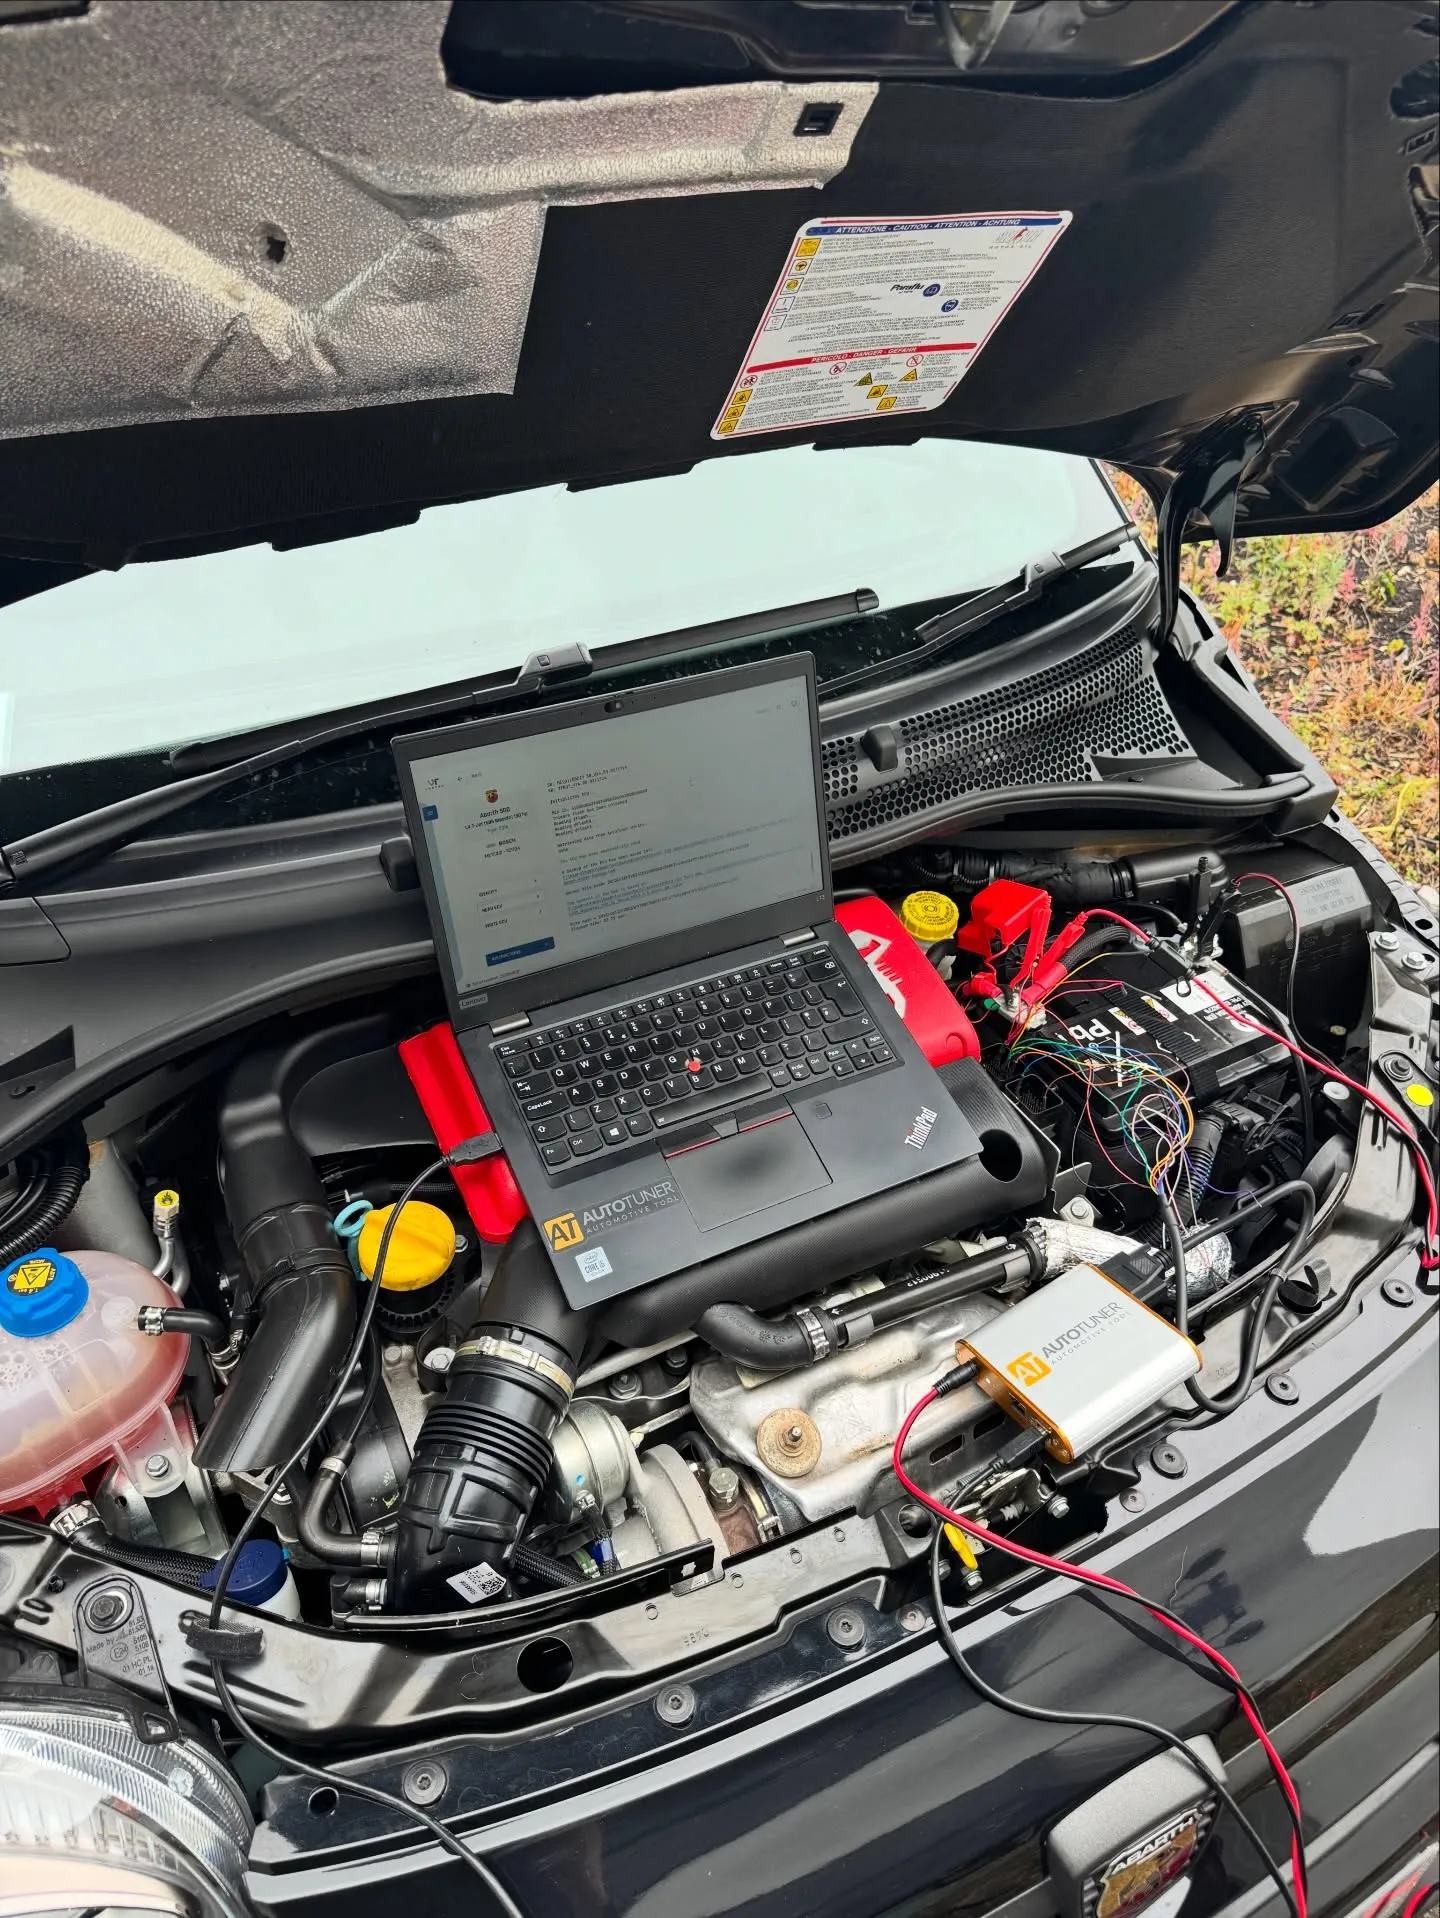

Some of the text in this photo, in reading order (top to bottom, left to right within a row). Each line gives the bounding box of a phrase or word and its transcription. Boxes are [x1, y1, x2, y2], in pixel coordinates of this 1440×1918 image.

[836, 226, 887, 234] ATTENZIONE
[890, 283, 925, 291] Paraflu
[811, 352, 849, 363] PERICOLO
[854, 350, 883, 358] DANGER
[462, 996, 486, 1007] Lenovo
[904, 1106, 938, 1149] ThinkPad
[583, 1182, 675, 1225] AUTOTUNER
[586, 1195, 679, 1234] AUTOMOTIVE TOOL
[552, 1218, 577, 1248] AT
[585, 1263, 599, 1273] CORE
[1041, 1302, 1124, 1358] AUTOTUNER
[1052, 1311, 1132, 1365] AUTOMOTIVE TOOL
[1015, 1356, 1044, 1380] AT
[106, 1636, 114, 1645] by
[1111, 1816, 1193, 1875] ABARTH
